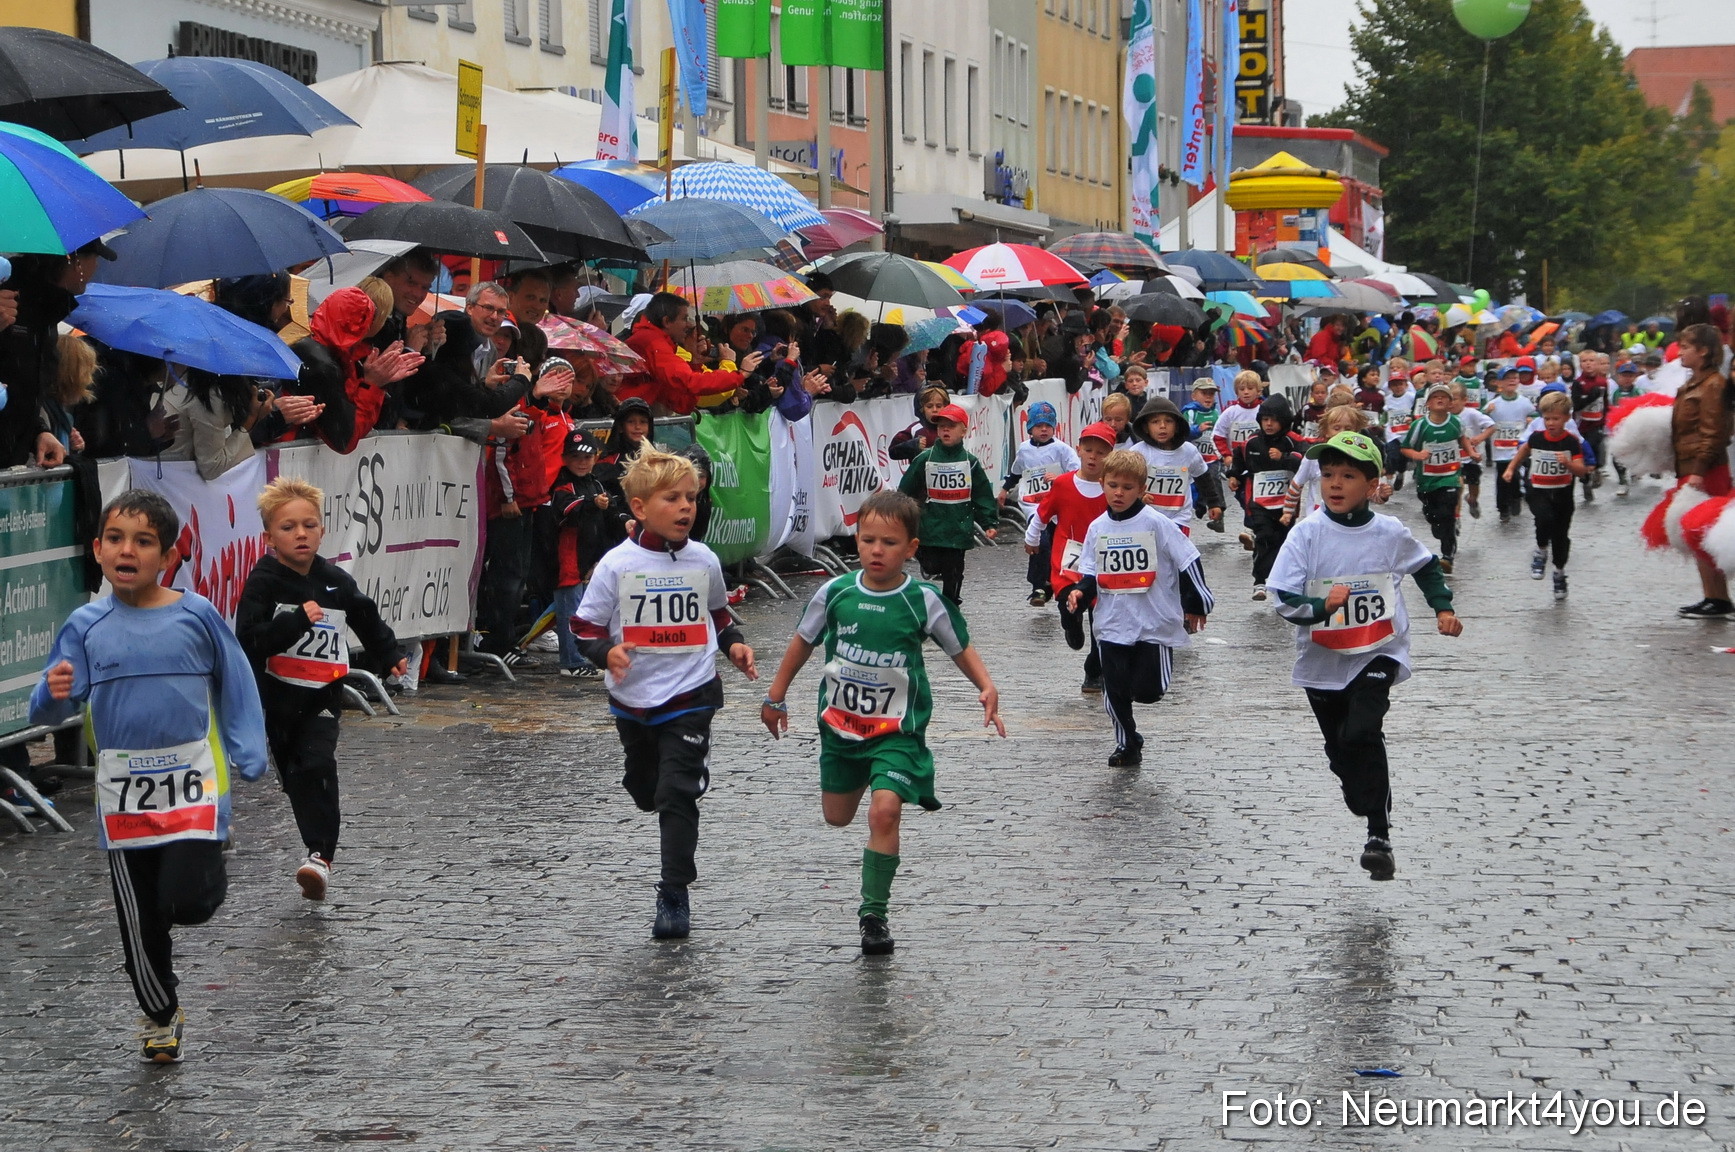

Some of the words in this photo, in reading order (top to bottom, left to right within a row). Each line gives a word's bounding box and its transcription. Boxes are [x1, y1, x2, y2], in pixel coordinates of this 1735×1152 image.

[930, 472, 966, 489] 7053
[1026, 476, 1053, 495] 703
[1147, 475, 1183, 494] 7172
[702, 507, 756, 545] llkommen
[1107, 537, 1133, 545] BOCK
[1099, 548, 1149, 572] 7309
[645, 576, 684, 587] BOCK
[5, 578, 36, 615] Action
[37, 575, 48, 609] in
[629, 592, 700, 624] 7106
[16, 622, 55, 663] Bahnen!
[649, 630, 687, 644] Jakob
[835, 638, 907, 668] Münch
[830, 676, 897, 716] 7057
[129, 753, 179, 769] BOCK
[110, 770, 204, 812] 7216
